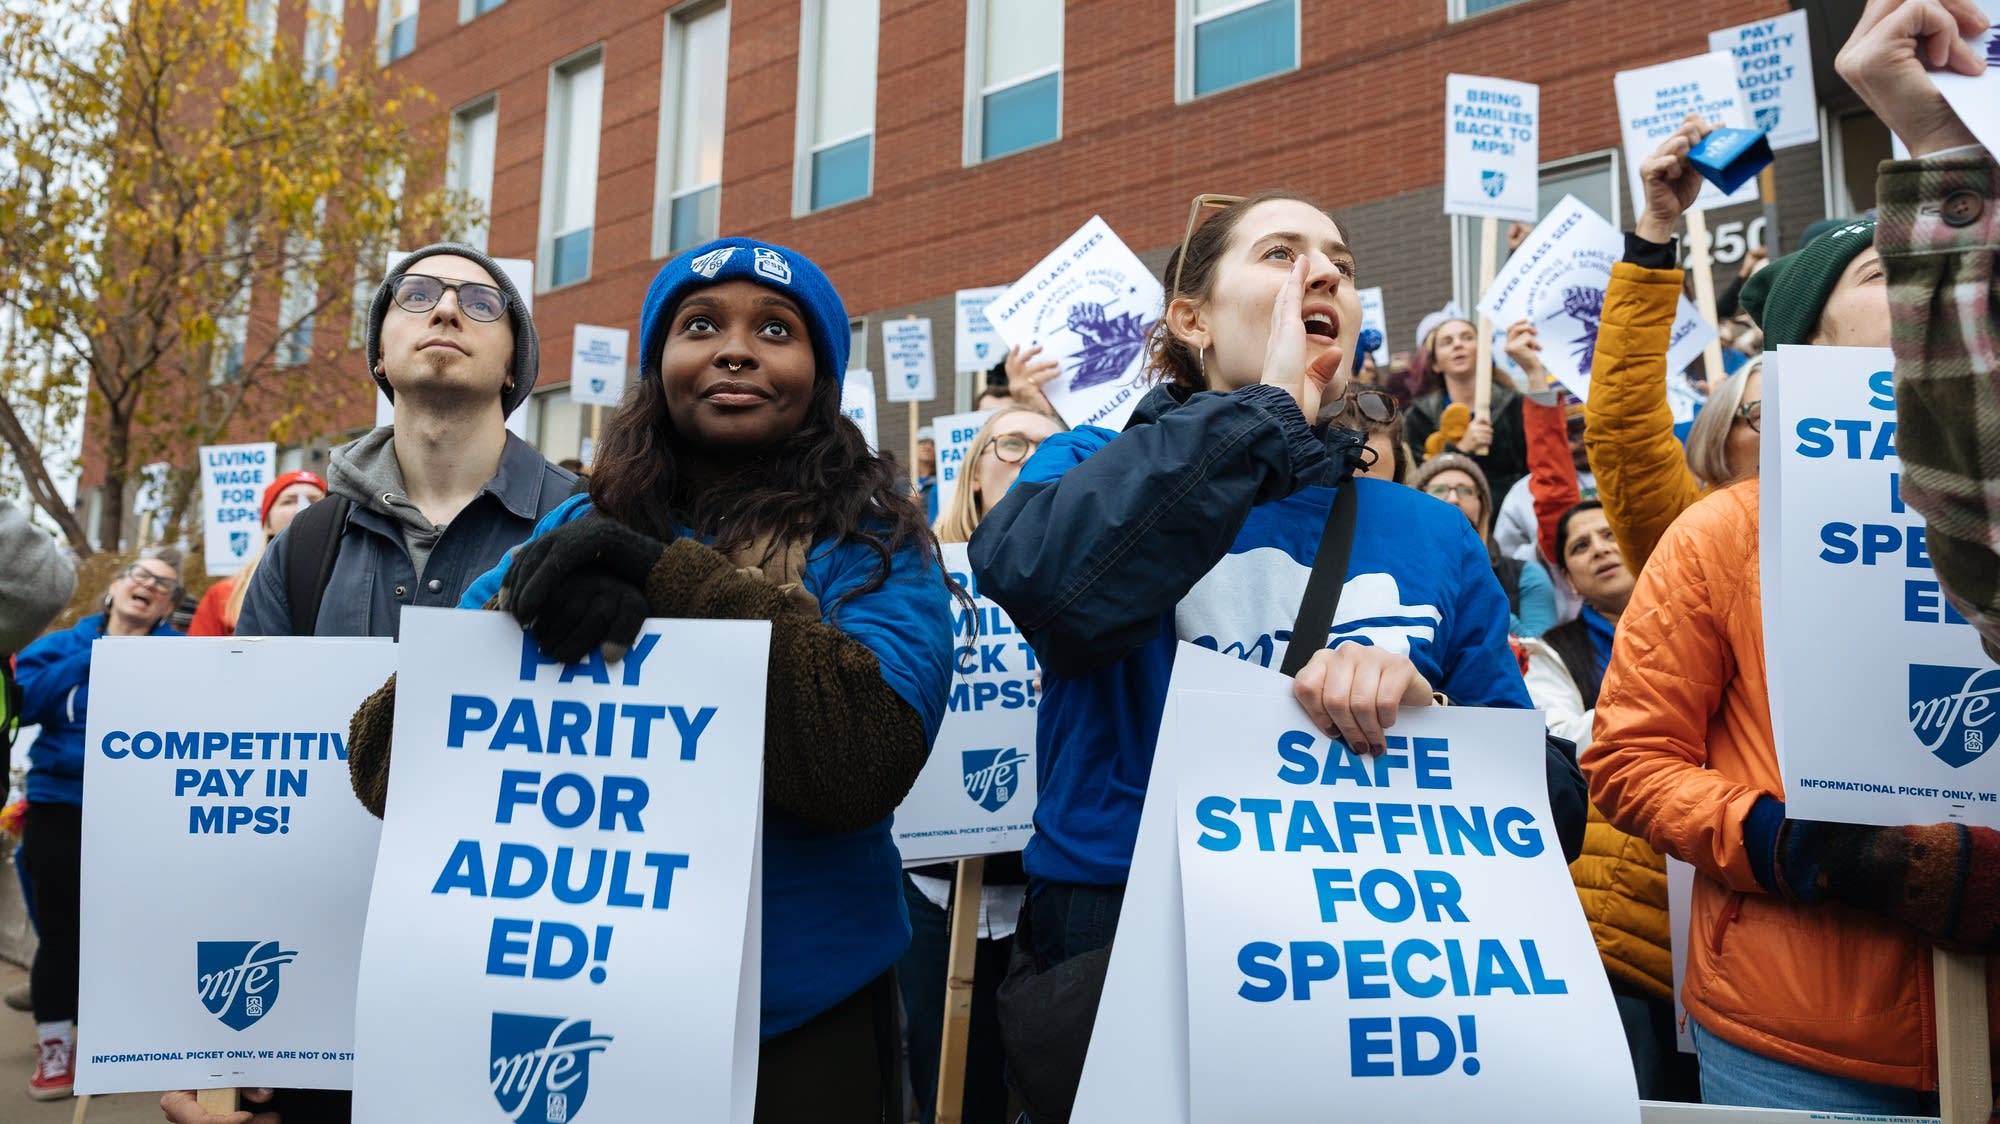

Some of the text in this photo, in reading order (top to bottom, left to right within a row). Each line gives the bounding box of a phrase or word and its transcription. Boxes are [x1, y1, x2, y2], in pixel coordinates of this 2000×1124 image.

[1740, 22, 1775, 41] PAY
[1741, 54, 1782, 73] FOR
[1466, 88, 1522, 108] BRING
[1656, 83, 1700, 98] MAKE
[1750, 87, 1780, 103] ED!
[1453, 104, 1533, 127] FAMILIES
[1455, 121, 1531, 142] BACK TO
[1472, 139, 1515, 156] MPS!
[1000, 232, 1104, 321] SAFER CLASS SIZES
[1493, 212, 1582, 312] SAFER CLASS SIZES
[1083, 389, 1131, 425] MALLER
[208, 451, 266, 467] LIVING
[213, 469, 262, 485] WAGE
[221, 489, 255, 503] FOR
[953, 642, 1037, 675] CK T
[447, 694, 719, 762] PARITY
[101, 730, 350, 761] COMPETITIV
[1277, 729, 1453, 790] SAFE
[175, 768, 308, 797] PAY IN
[1800, 778, 1998, 802] INFORMATIONAL PICKET ONLY, WE
[495, 769, 650, 833] FOR
[189, 805, 291, 834] MPS!
[899, 829, 958, 840] INFORMATIONAL
[959, 827, 984, 835] PICKET
[1195, 795, 1545, 859] STAFFING
[431, 839, 690, 911] ADULT
[1312, 867, 1471, 923] FOR
[485, 917, 614, 985] ED!
[1237, 938, 1569, 1003] SPECIAL
[91, 1052, 184, 1064] INFORMATIONAL
[186, 1050, 224, 1060] PICKET
[226, 1050, 256, 1059] ONLY,
[258, 1050, 274, 1059] WE
[276, 1051, 296, 1059] ARE
[299, 1051, 320, 1060] NOT
[321, 1051, 337, 1060] ON
[1348, 1014, 1481, 1078] ED!
